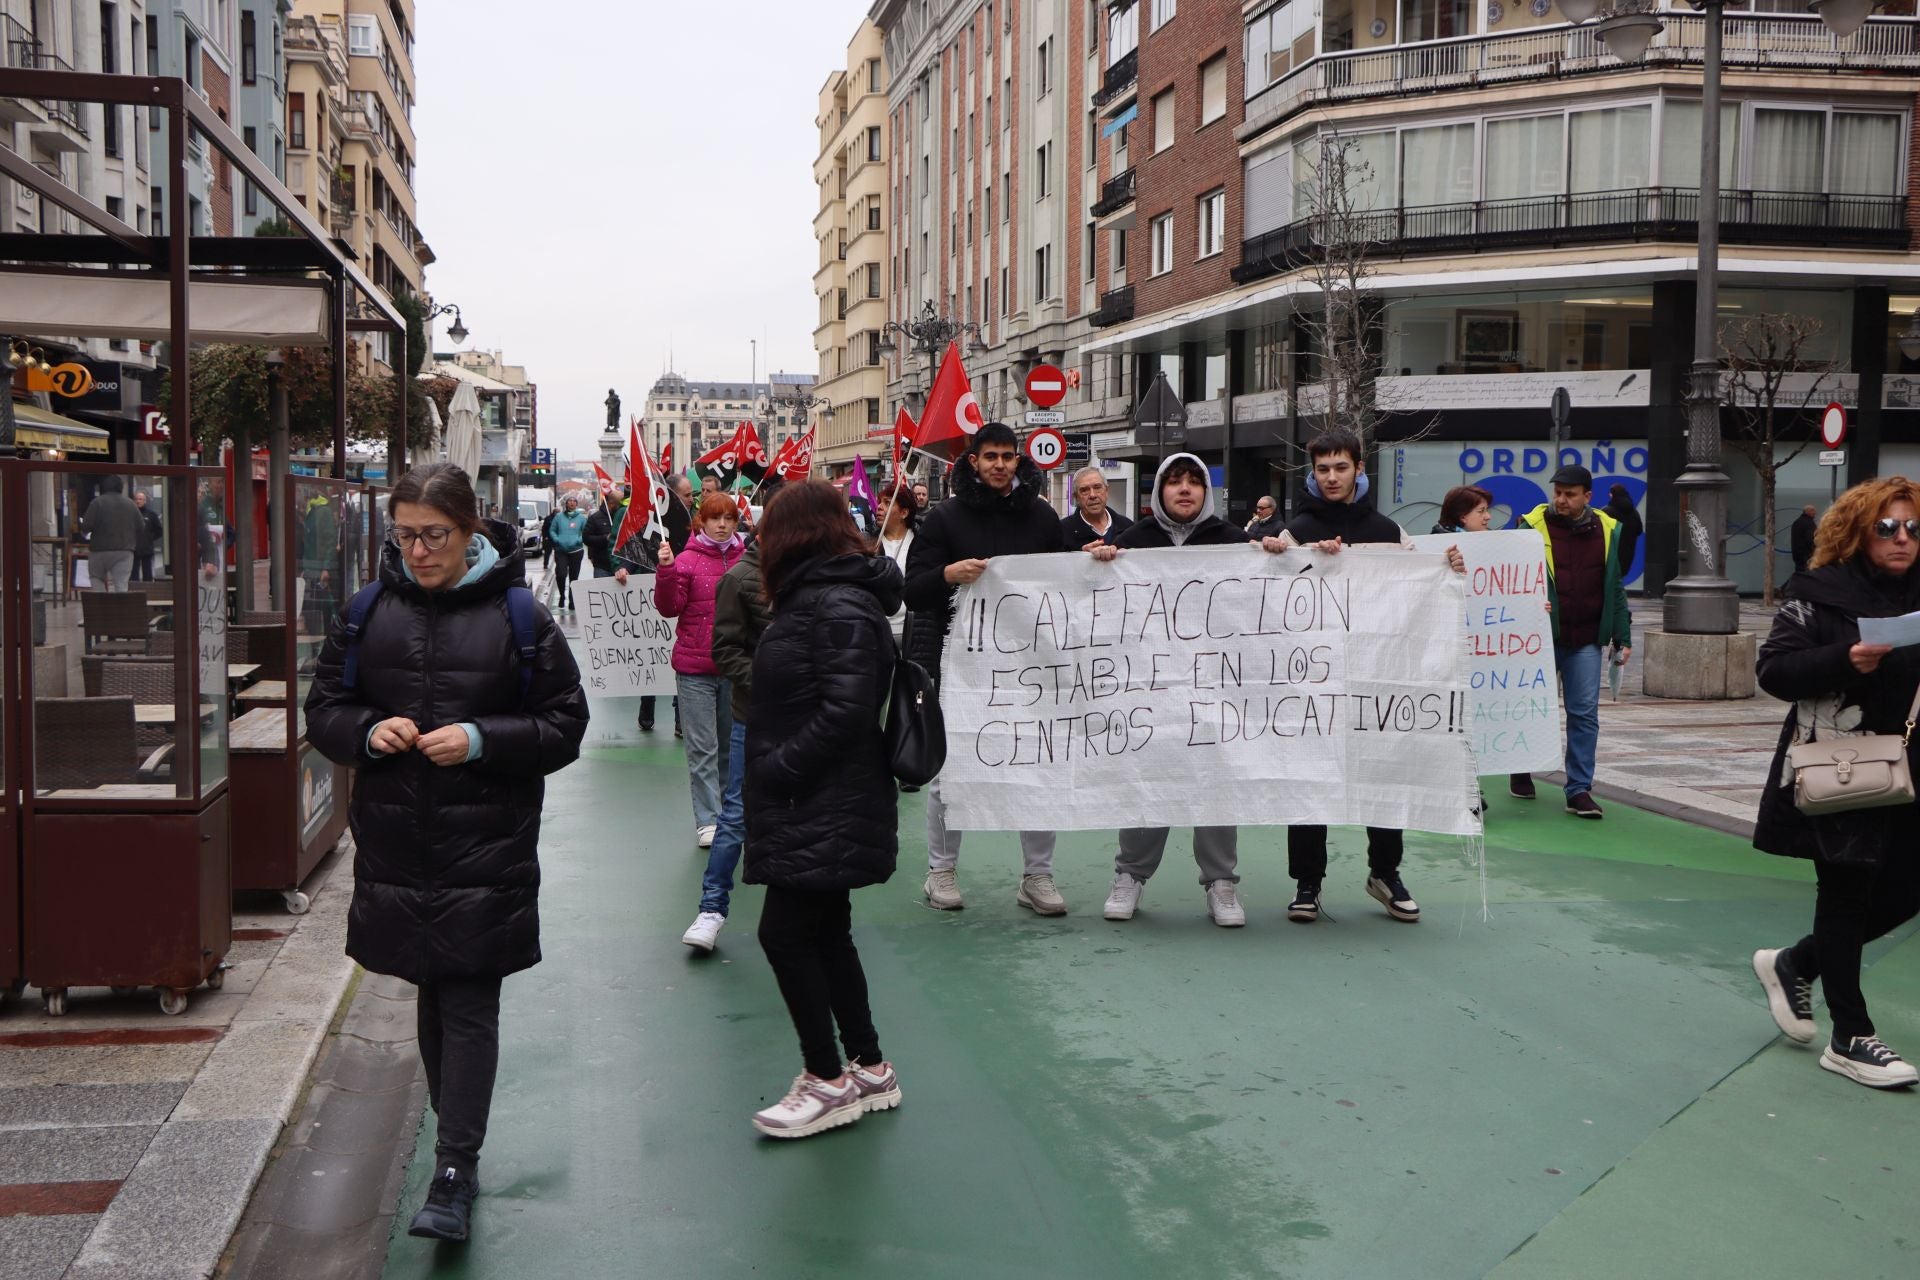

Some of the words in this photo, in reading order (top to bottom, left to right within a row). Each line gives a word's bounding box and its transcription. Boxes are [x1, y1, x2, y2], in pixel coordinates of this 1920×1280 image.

[97, 381, 118, 390] DUO
[536, 450, 546, 463] P
[1037, 443, 1055, 456] 10
[1459, 439, 1649, 474] ORDOÑO
[1466, 561, 1546, 598] ONILLA
[1484, 606, 1516, 626] EL
[584, 623, 603, 644] DE
[611, 618, 672, 641] CALIDAD
[589, 646, 643, 670] BUENAS
[590, 676, 607, 690] NES
[987, 652, 1171, 707] ESTABLE
[1194, 651, 1242, 690] EN
[1269, 645, 1332, 685] LOS
[1518, 669, 1547, 688] LA
[976, 706, 1154, 767] CENTROS
